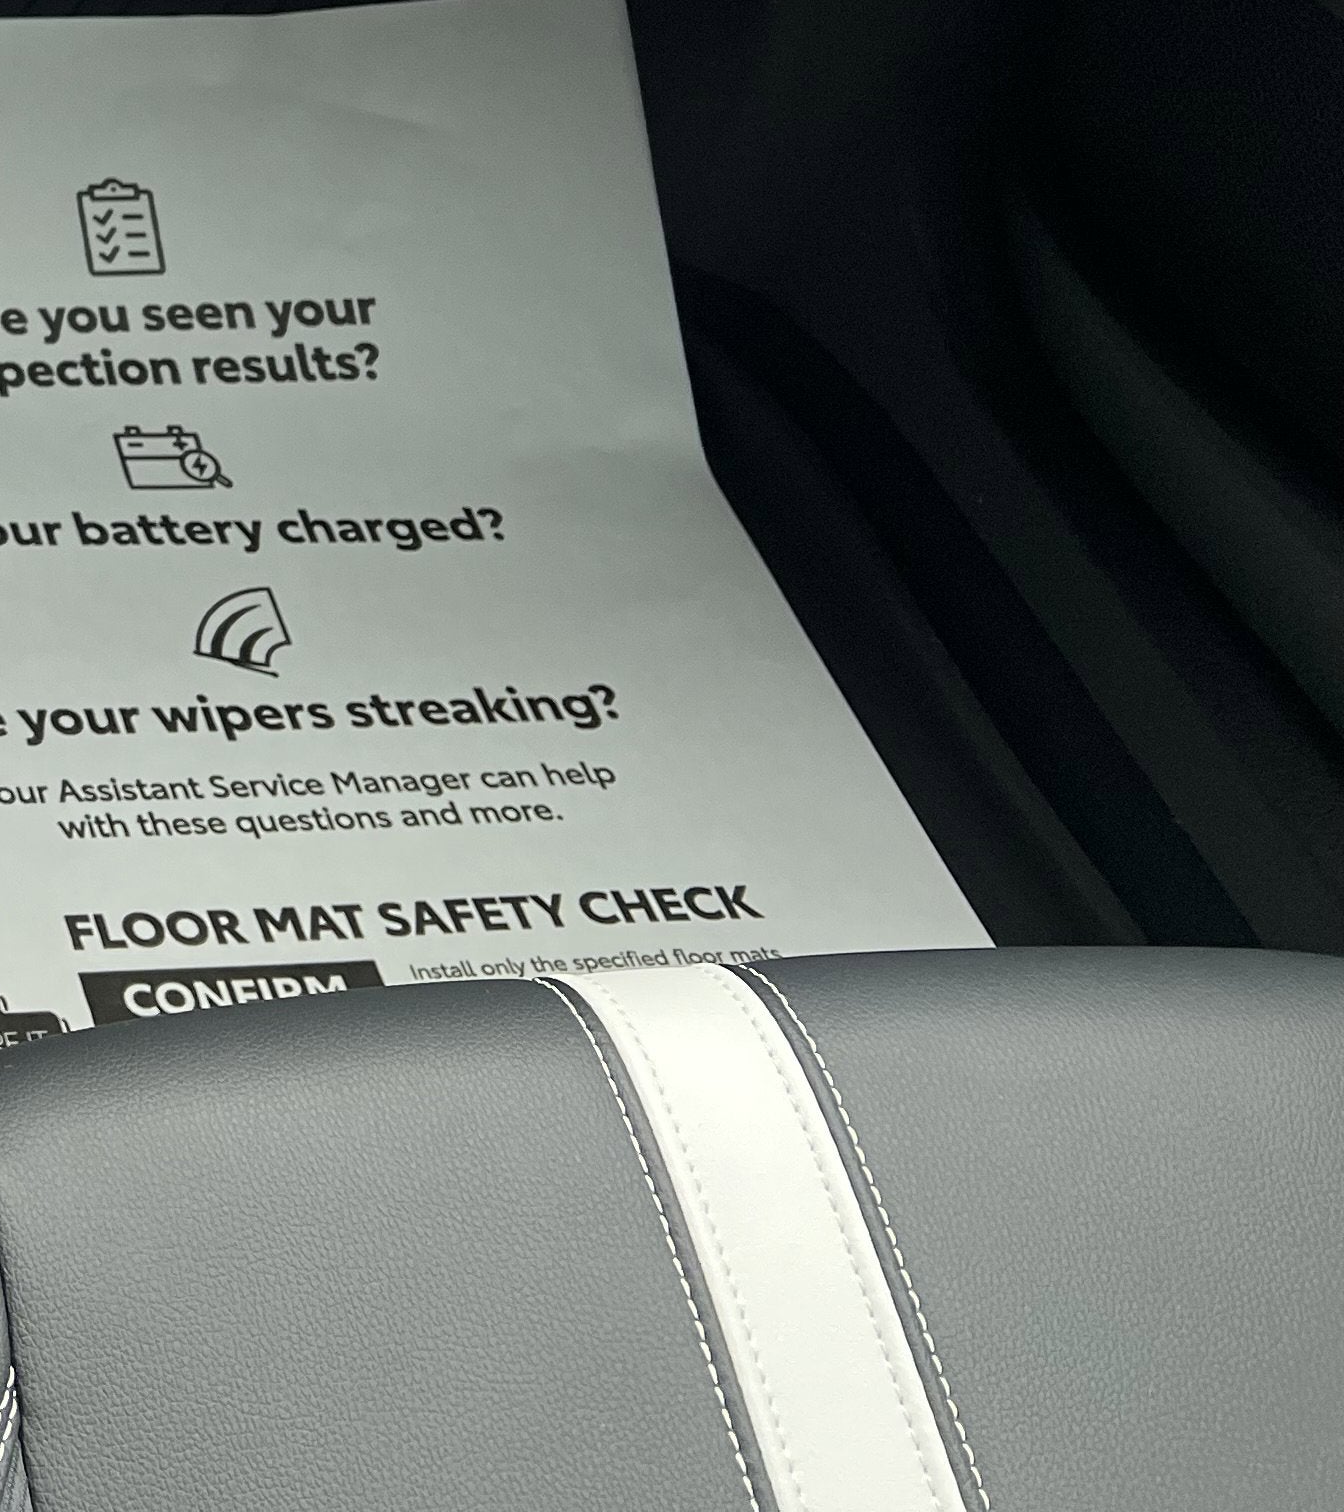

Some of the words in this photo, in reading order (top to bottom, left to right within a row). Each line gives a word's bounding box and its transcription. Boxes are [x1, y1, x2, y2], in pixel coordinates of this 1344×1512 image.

[37, 305, 130, 345] you
[141, 301, 257, 332] seen
[264, 297, 377, 339] your
[191, 342, 380, 385] results?
[71, 511, 262, 554] battery
[277, 506, 505, 552] charged?
[16, 707, 140, 747] your
[151, 694, 335, 742] wipers
[345, 684, 619, 730] streaking?
[59, 777, 205, 803] Assistant
[208, 772, 326, 799] Service
[329, 771, 471, 797] Manager
[480, 770, 539, 789] can
[540, 761, 617, 790] help
[57, 812, 131, 839] with
[136, 811, 228, 837] these
[235, 806, 393, 840] questions
[400, 800, 463, 827] and
[469, 804, 564, 825] more.
[63, 909, 250, 951] FLOOR
[252, 903, 365, 943] MAT
[377, 893, 565, 937] SAFETY
[578, 884, 765, 925] CHECK
[409, 962, 474, 981] Install
[481, 957, 526, 980] only
[529, 955, 568, 974] the
[574, 949, 669, 974] specified
[671, 947, 723, 965] floor
[731, 946, 783, 962] mats
